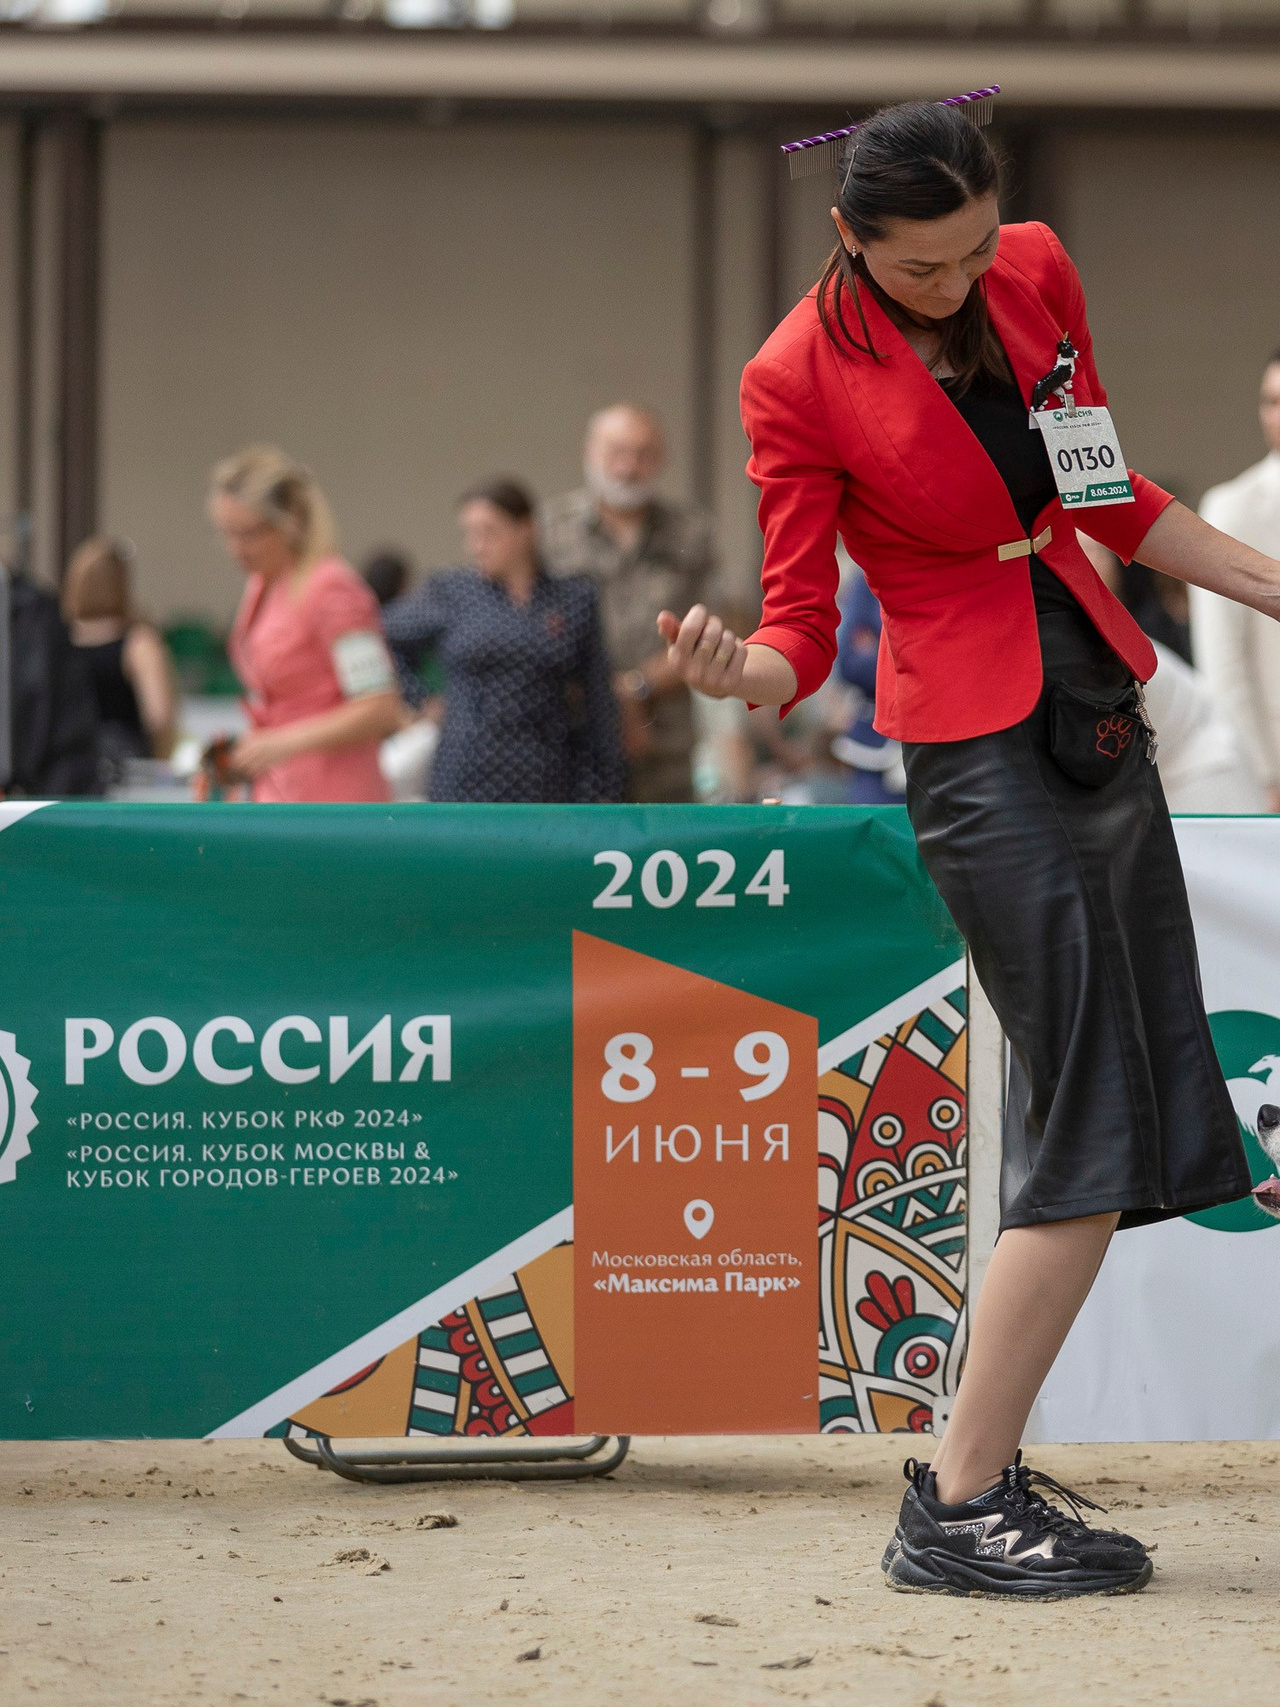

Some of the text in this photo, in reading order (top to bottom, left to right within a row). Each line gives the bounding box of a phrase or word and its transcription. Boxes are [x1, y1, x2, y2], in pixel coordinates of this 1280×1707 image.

[1057, 444, 1115, 473] 0130
[1090, 485, 1128, 498] 8.06.2024
[592, 849, 790, 909] 2024
[64, 1013, 452, 1086] РОССИЯ
[600, 1032, 657, 1104] 8
[733, 1030, 790, 1102] 9
[67, 1109, 423, 1130] «РОССИЯ. КУБОК РКФ 2024»
[67, 1141, 431, 1163] «РОССИЯ. КУБОК МОСКВЫ &
[605, 1123, 789, 1163] ИЮНЯ
[67, 1166, 458, 1190] КУБОК ГОРОДОВ-ГЕРОЕВ 2024»
[591, 1247, 803, 1268] Московская область,
[593, 1271, 801, 1299] «Максима Парк»
